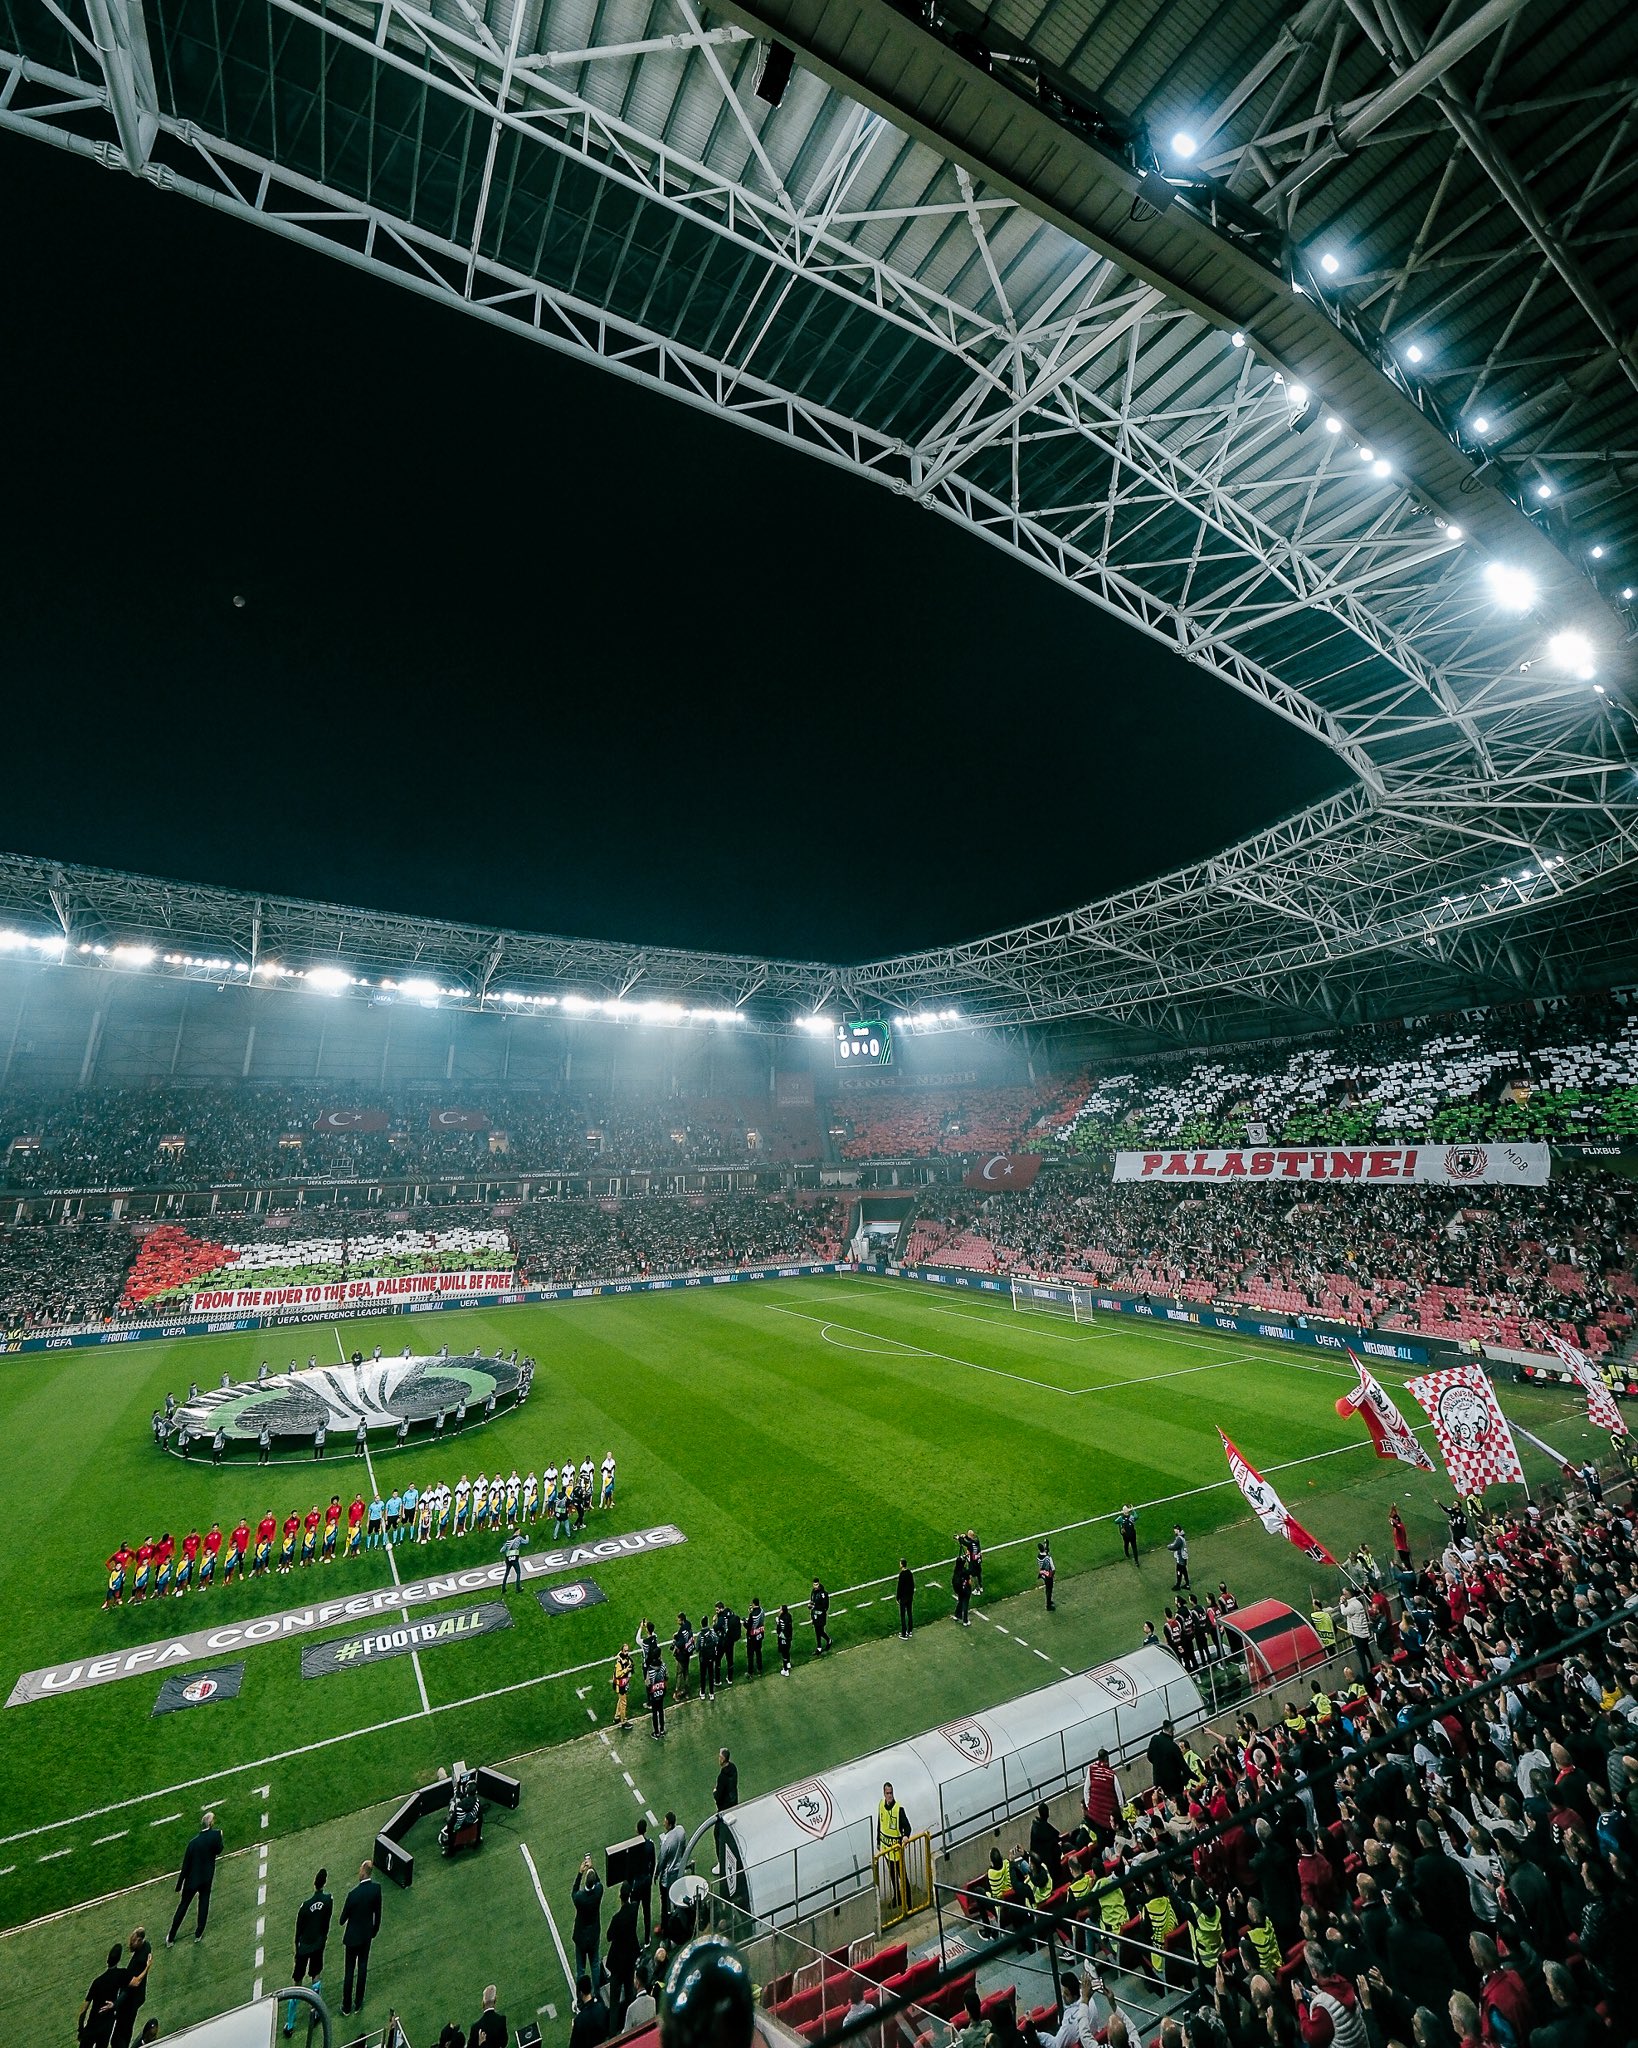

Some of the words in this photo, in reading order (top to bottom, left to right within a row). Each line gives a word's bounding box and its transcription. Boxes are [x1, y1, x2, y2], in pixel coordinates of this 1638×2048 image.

[840, 1041, 849, 1058] 0
[870, 1039, 879, 1056] 0
[1582, 1147, 1621, 1155] FLIXBUS
[810, 1266, 824, 1274] UEFA
[907, 1271, 918, 1279] UEFA
[685, 1278, 700, 1286] UEFA
[955, 1277, 968, 1286] UEFA
[194, 1291, 233, 1309] FROM
[236, 1291, 262, 1306] THE
[263, 1289, 301, 1306] RIVER
[303, 1286, 321, 1302] TO
[324, 1283, 347, 1300] THE
[348, 1281, 374, 1298] SEA,
[376, 1275, 437, 1296] PALESTINE
[439, 1274, 467, 1291] WILL
[469, 1274, 483, 1289] BE
[485, 1274, 511, 1290] FREE
[541, 1292, 558, 1300] UEFA
[460, 1300, 479, 1308] UEFA
[277, 1316, 299, 1324] UEFA
[301, 1310, 355, 1322] CONFERENCE
[356, 1307, 388, 1317] LEAGUE
[1135, 1305, 1152, 1316] UEFA
[1216, 1318, 1237, 1329] UEFA
[162, 1327, 186, 1336] UEFA
[100, 1331, 141, 1343] #FOOTBALL
[1315, 1335, 1341, 1348] UEFA
[6, 1342, 22, 1352] ALL
[46, 1338, 72, 1348] UEFA
[41, 1643, 191, 1689] UEFA
[206, 1566, 507, 1649] CONFERENCE
[522, 1529, 669, 1573] LEAGUE
[335, 1611, 484, 1662] #FOOTBALL
[810, 1814, 823, 1826] 1965
